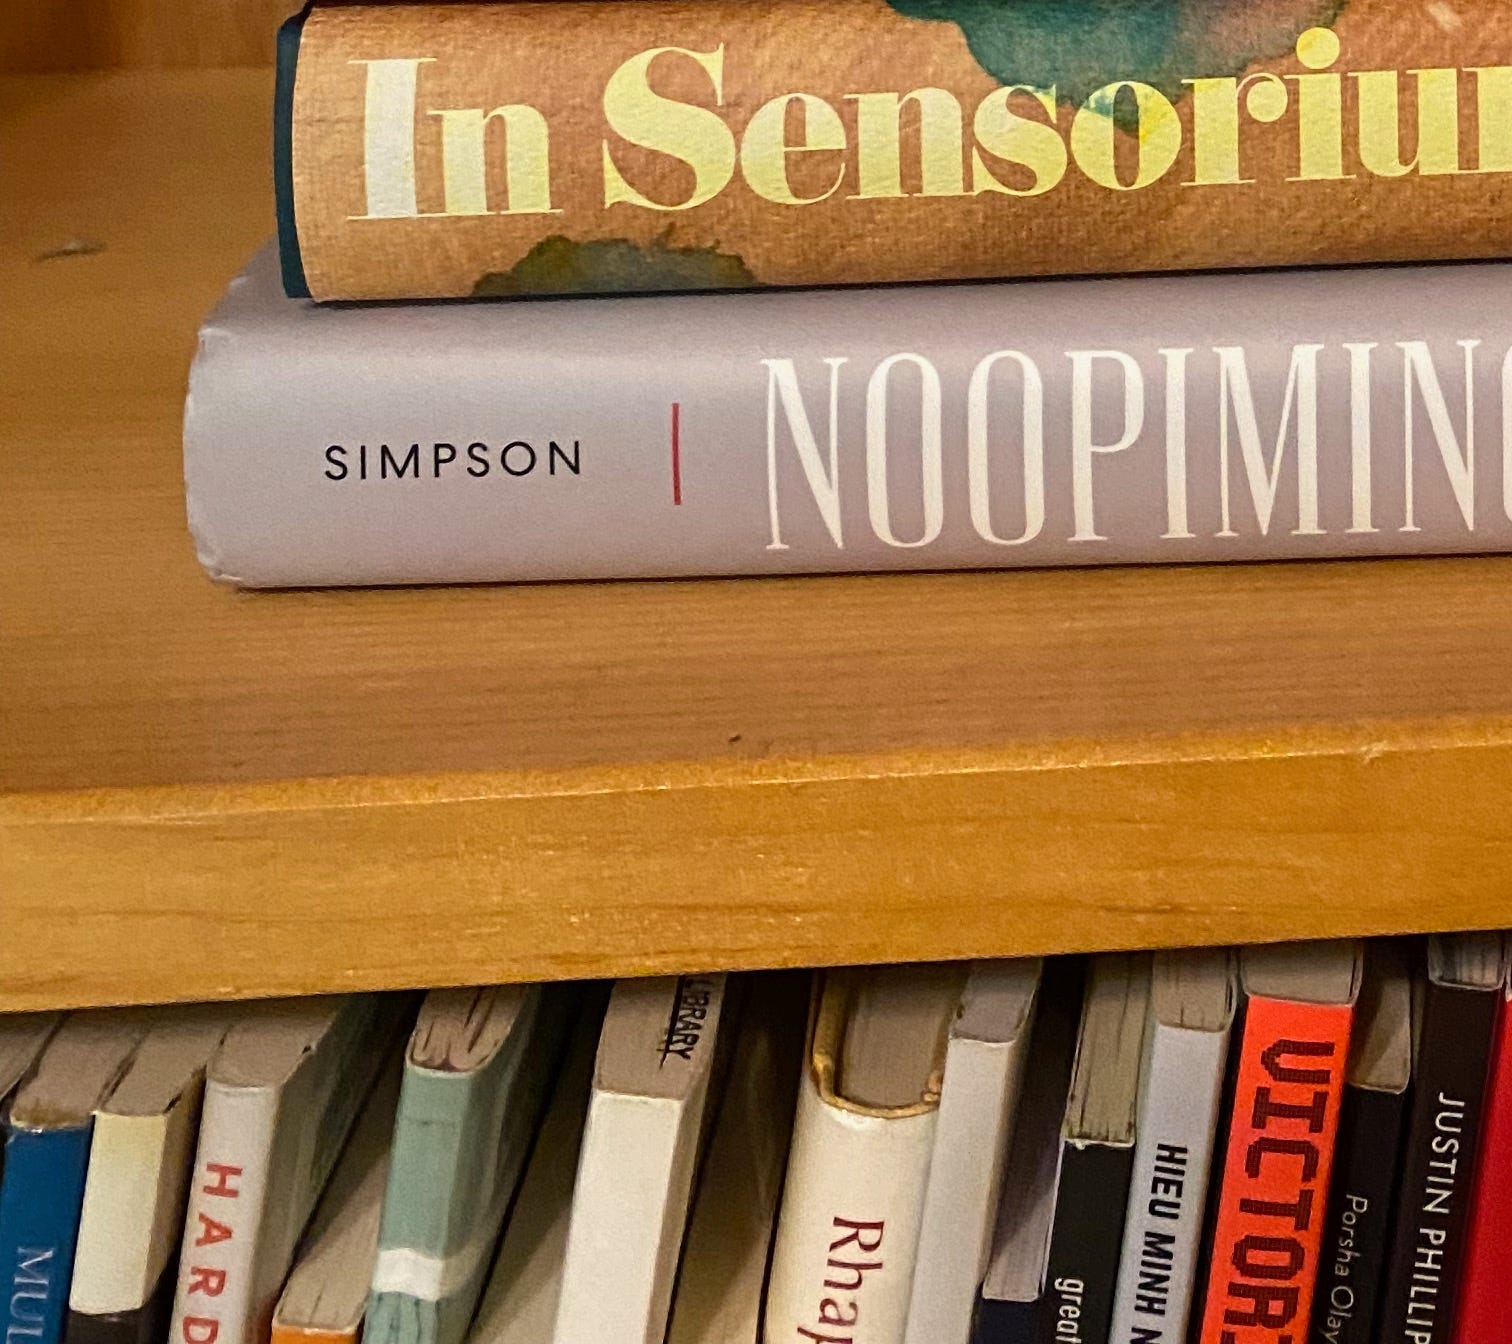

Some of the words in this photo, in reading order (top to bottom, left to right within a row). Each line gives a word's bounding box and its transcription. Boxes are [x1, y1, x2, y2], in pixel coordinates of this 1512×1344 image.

[347, 56, 564, 221] In
[324, 440, 582, 481] SIMPSON
[1147, 1143, 1188, 1220] HIEU
[1422, 1092, 1465, 1214] JUSTIN
[1133, 1230, 1176, 1316] MINH
[1334, 1192, 1368, 1278] Porsha
